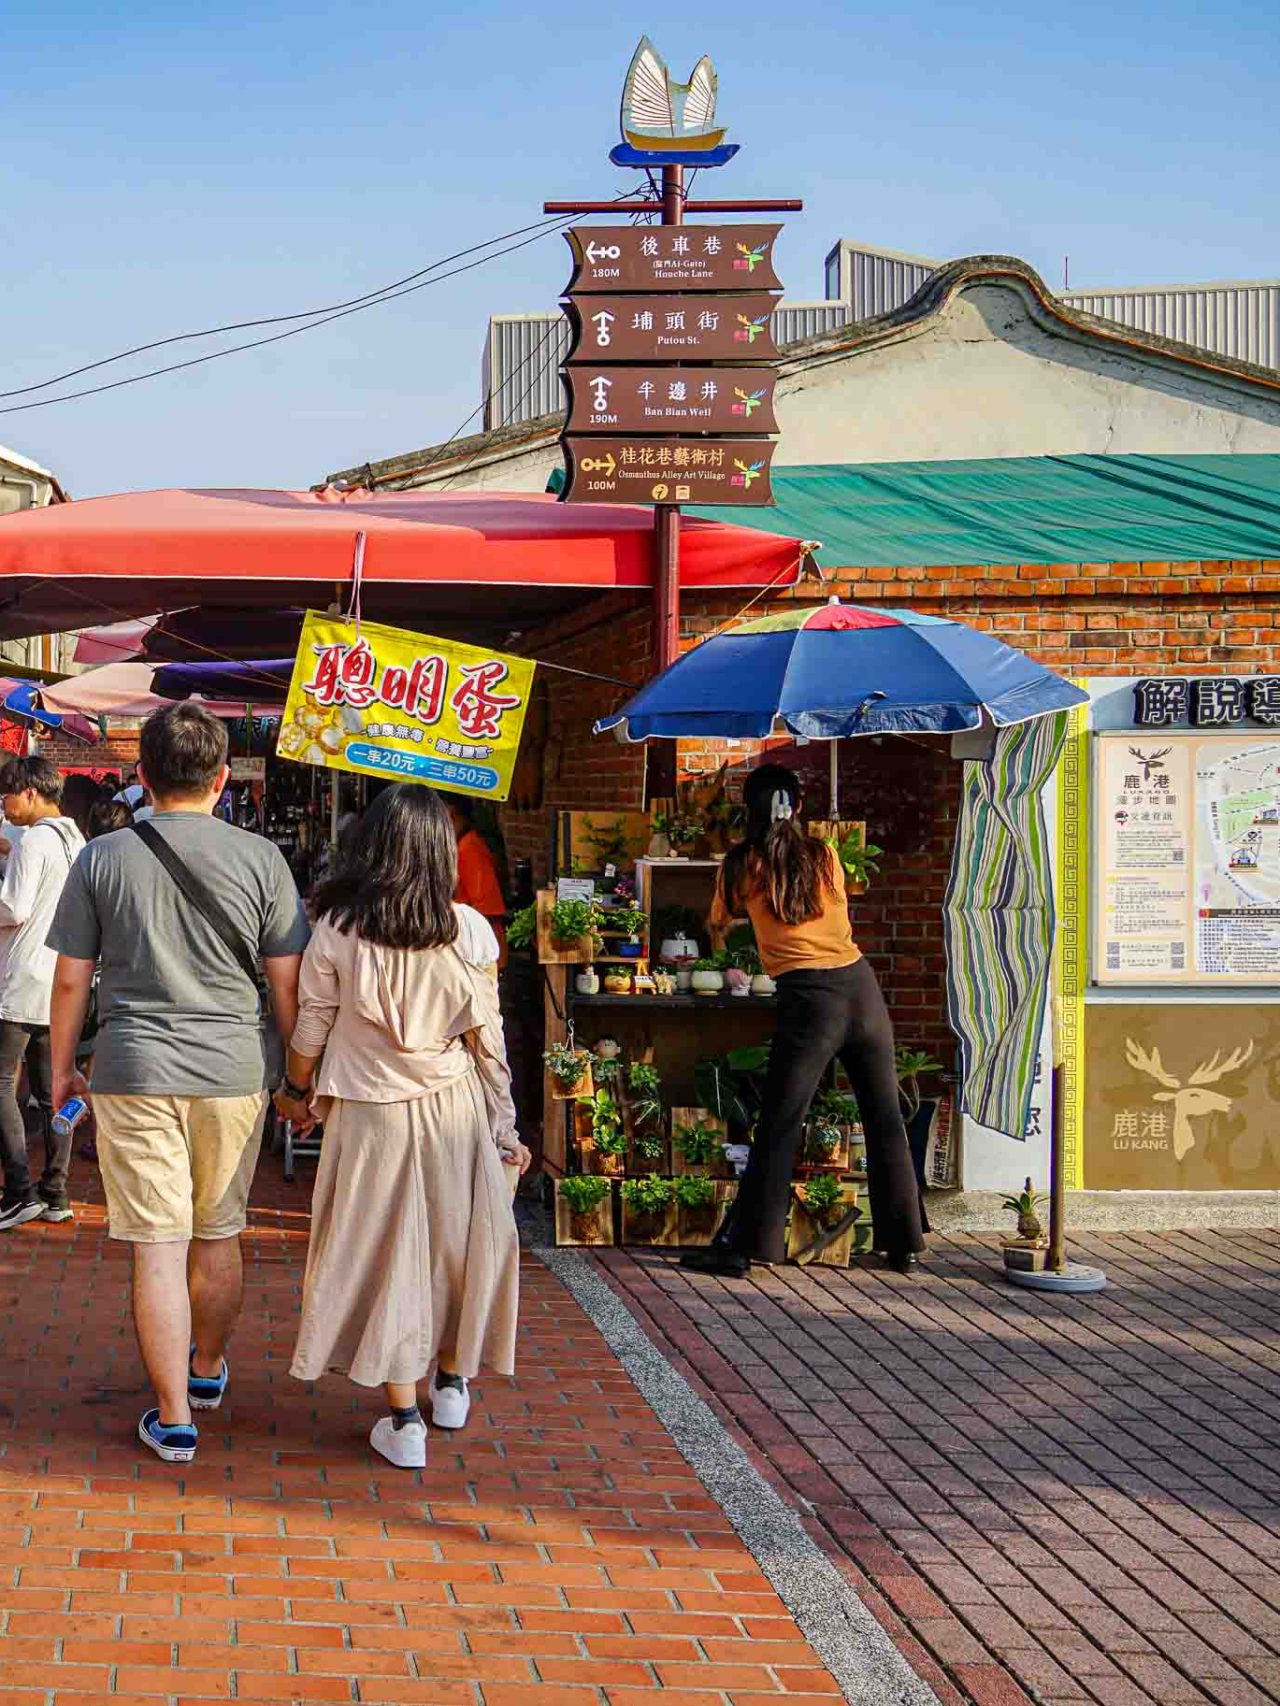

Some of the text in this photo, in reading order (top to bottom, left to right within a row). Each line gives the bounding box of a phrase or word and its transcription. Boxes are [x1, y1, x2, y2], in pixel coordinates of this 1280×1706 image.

[639, 235, 722, 256] 後車巷
[592, 268, 620, 278] 180M
[655, 270, 714, 278] Houche Lane
[631, 310, 720, 331] 埔頭街
[657, 336, 701, 345] Putou St.
[637, 381, 718, 401] 半邊井
[644, 407, 711, 417] Ban Bian Well
[589, 414, 618, 424] 190M
[619, 446, 725, 467] 桂花巷藝術村
[618, 470, 660, 479] Osmanthus
[661, 470, 683, 480] Alley
[683, 471, 696, 480] Art
[697, 471, 726, 481] Village
[587, 481, 616, 490] 100M
[302, 638, 521, 738] 聰明蛋
[1123, 774, 1170, 789] 鹿港
[1111, 1109, 1168, 1138] 鹿港
